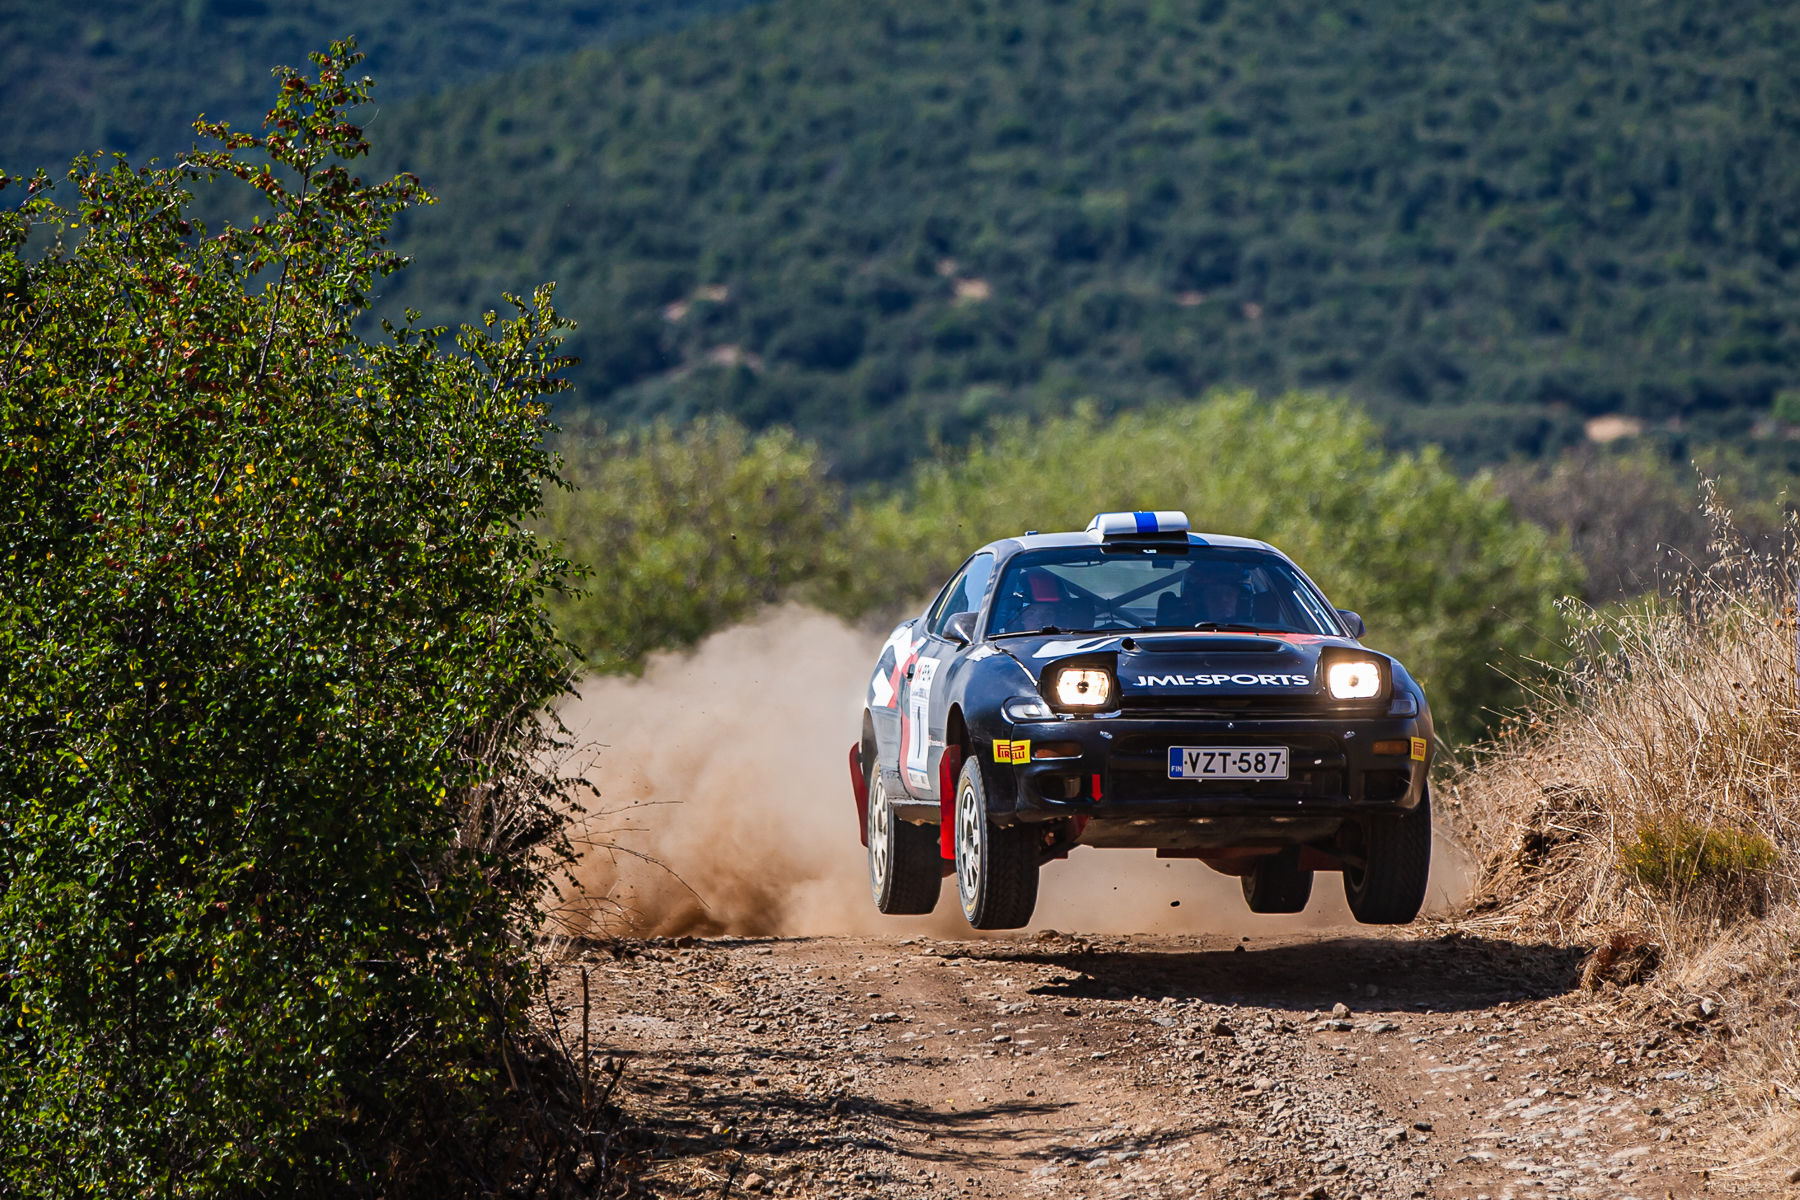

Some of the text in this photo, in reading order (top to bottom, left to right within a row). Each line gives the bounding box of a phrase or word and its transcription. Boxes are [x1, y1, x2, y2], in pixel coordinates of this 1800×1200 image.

[1132, 674, 1310, 686] JML-SPORTS
[997, 744, 1025, 760] PIRELLI
[1188, 752, 1282, 773] VZT-587
